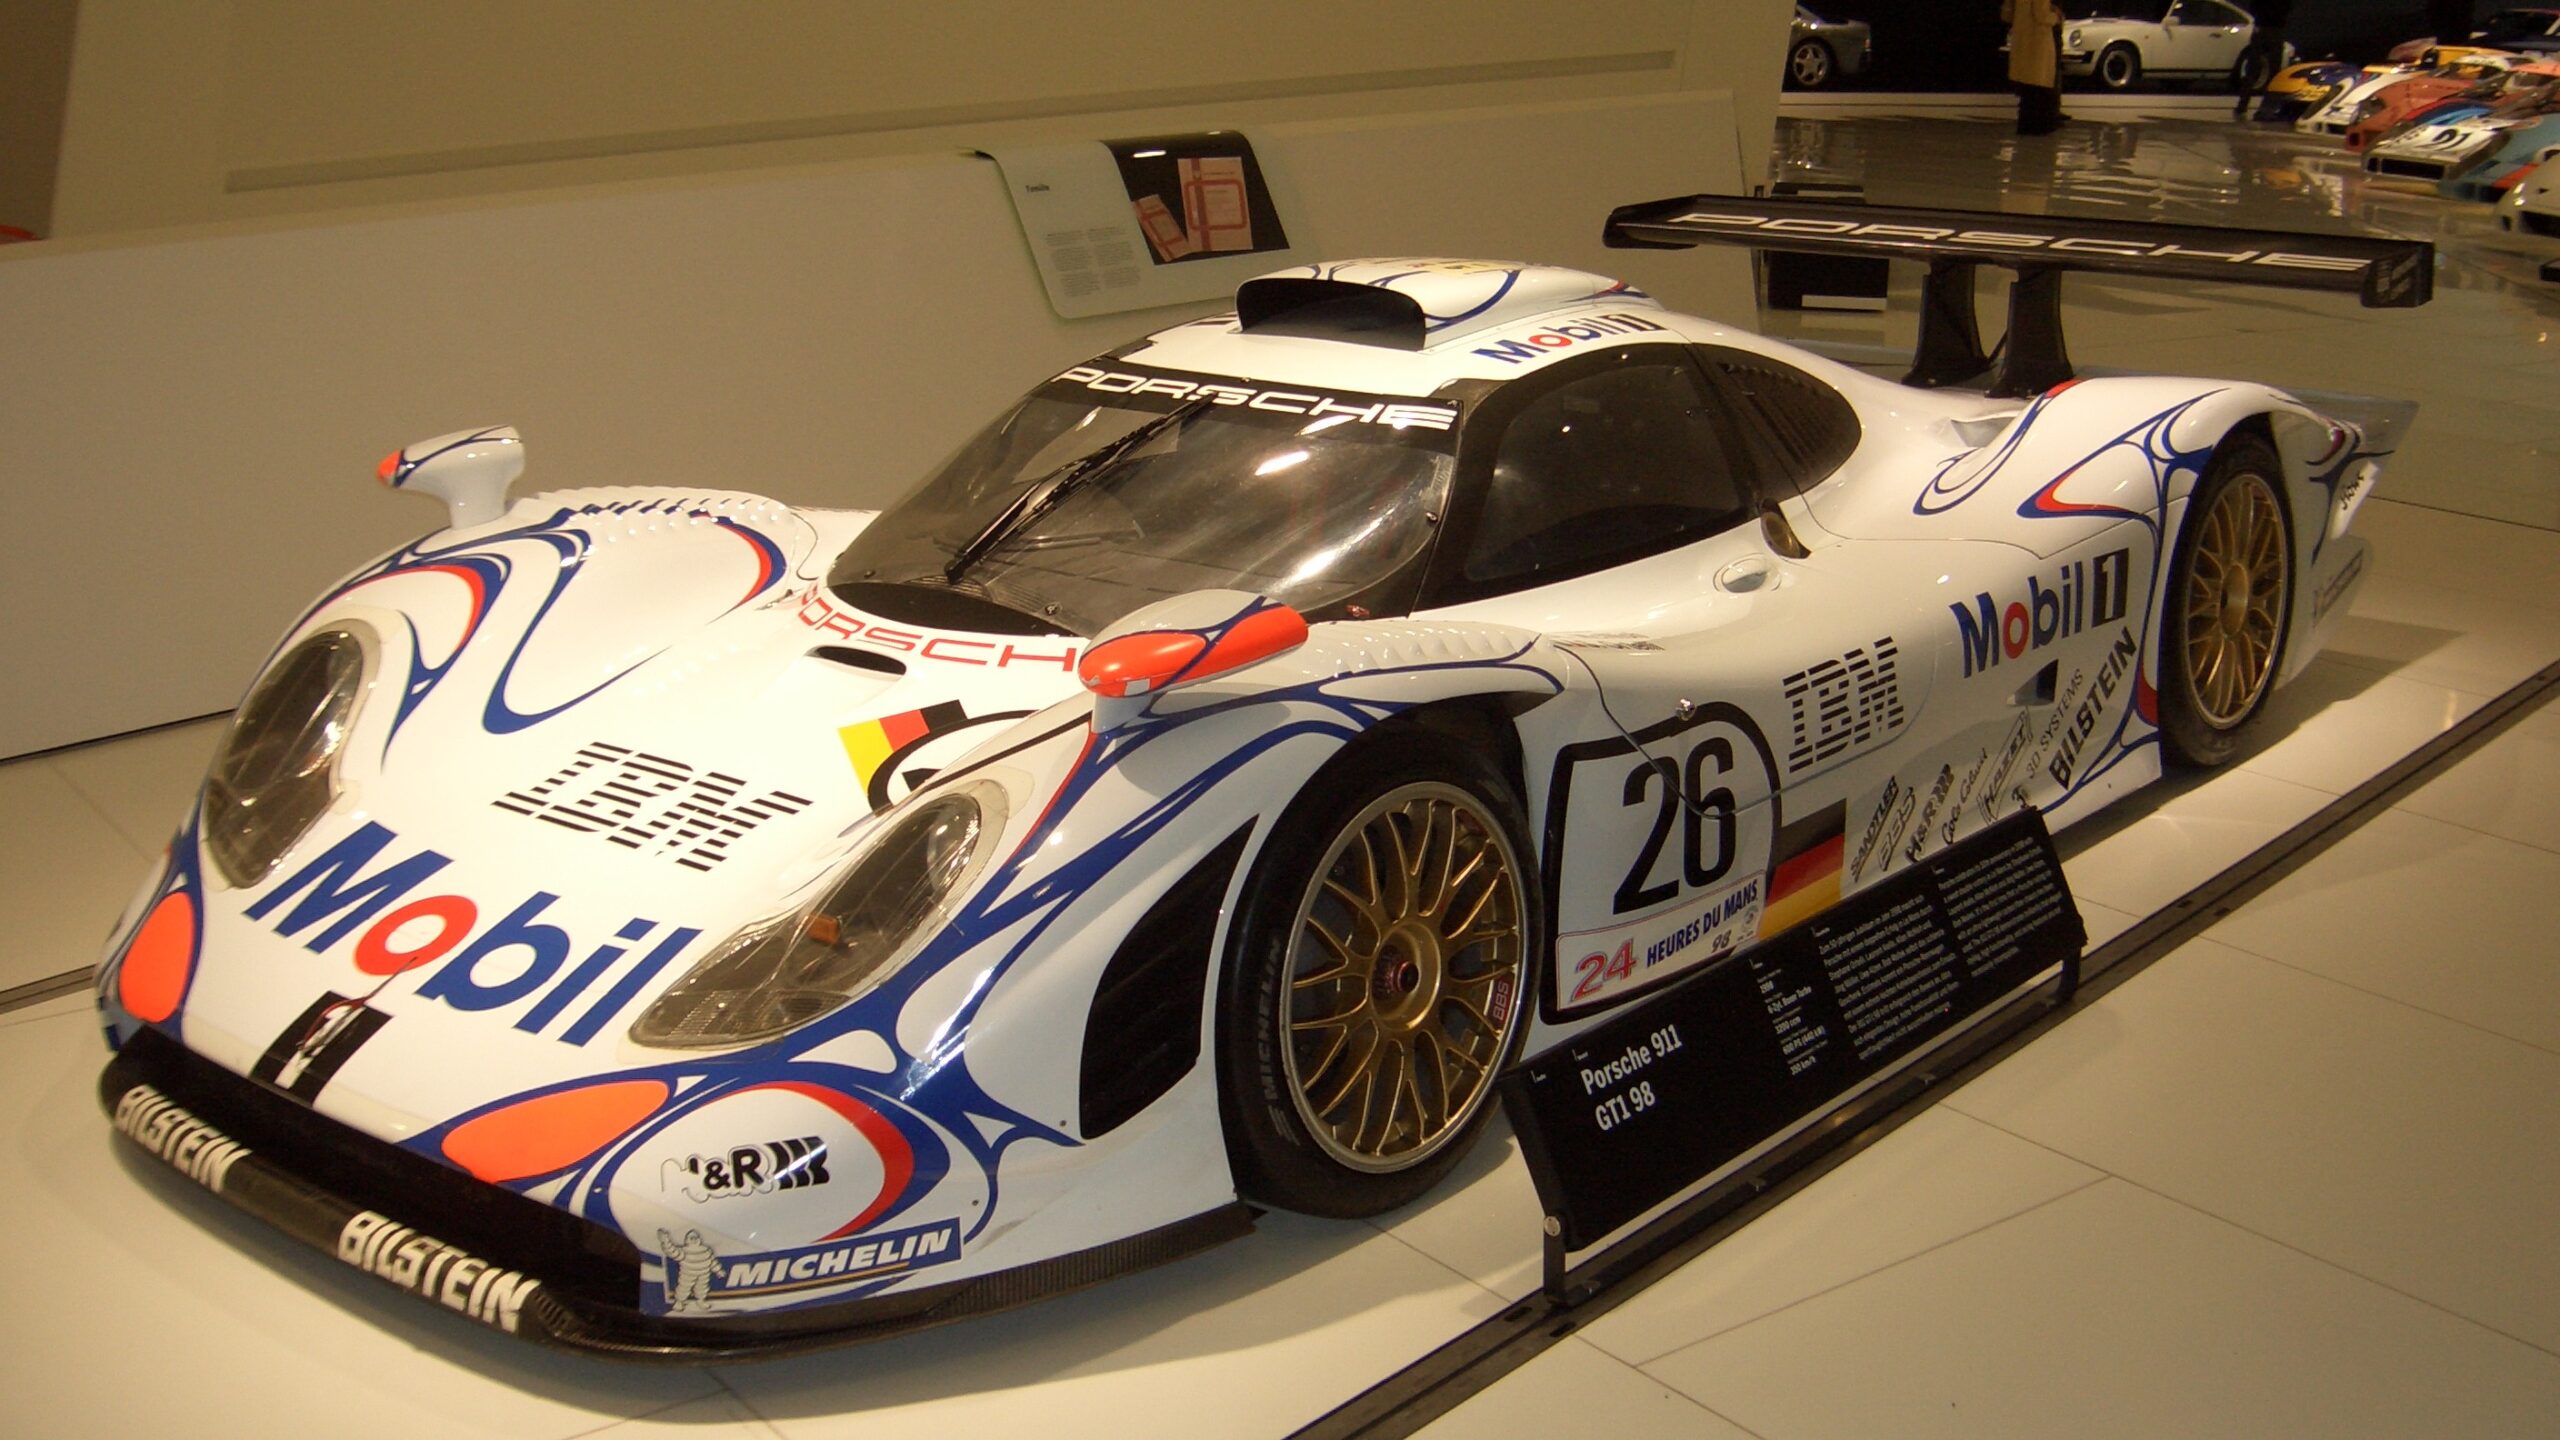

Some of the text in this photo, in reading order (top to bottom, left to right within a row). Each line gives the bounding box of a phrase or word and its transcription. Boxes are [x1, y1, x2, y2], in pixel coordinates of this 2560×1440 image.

[1668, 214, 2372, 270] PORSCHE
[1470, 316, 1631, 365] Mobil
[1051, 367, 1457, 431] PORSCHE
[800, 583, 1077, 672] PORSCH
[1949, 561, 2083, 679] Mobil
[1783, 636, 1904, 774] IBM
[2039, 668, 2084, 754] SYSTEMS
[2048, 626, 2138, 791] BILSTEIN
[490, 742, 814, 872] IBM
[1613, 737, 1737, 915] 26
[1850, 774, 1898, 877] SANDTLER
[241, 820, 705, 1047] Mobil
[1571, 878, 1758, 1002] 24 HEURES DU MANS
[1580, 1024, 1682, 1096] Porsche 911
[1595, 1080, 1656, 1131] GT1 98
[116, 1084, 253, 1194] BILSTEIN
[338, 1210, 542, 1334] BILSTEIN
[726, 1228, 953, 1289] MICHELIN
